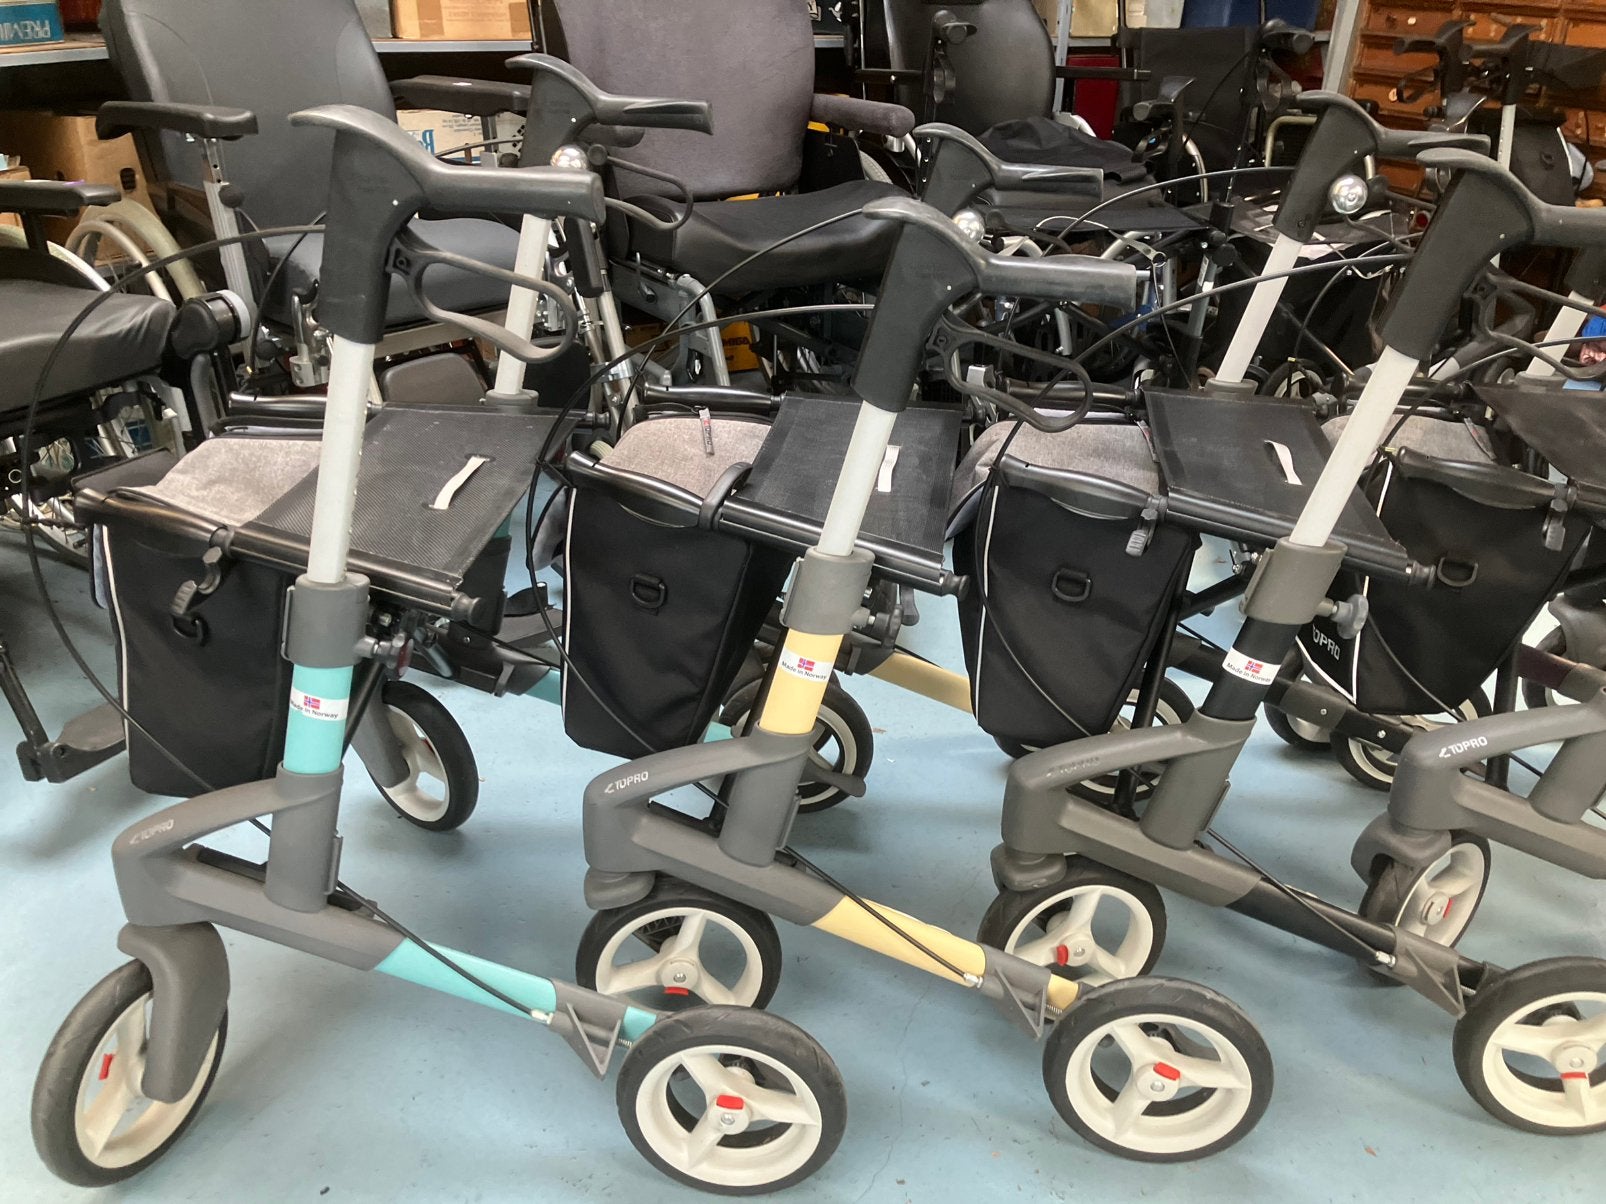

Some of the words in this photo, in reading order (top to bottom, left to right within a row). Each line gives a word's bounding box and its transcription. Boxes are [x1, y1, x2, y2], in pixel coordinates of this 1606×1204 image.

[781, 660, 797, 672] Made
[804, 671, 828, 680] Norway
[1226, 662, 1243, 675] Made
[312, 709, 339, 719] Norway
[1448, 736, 1488, 755] TOPRO
[614, 771, 649, 791] TOPRO
